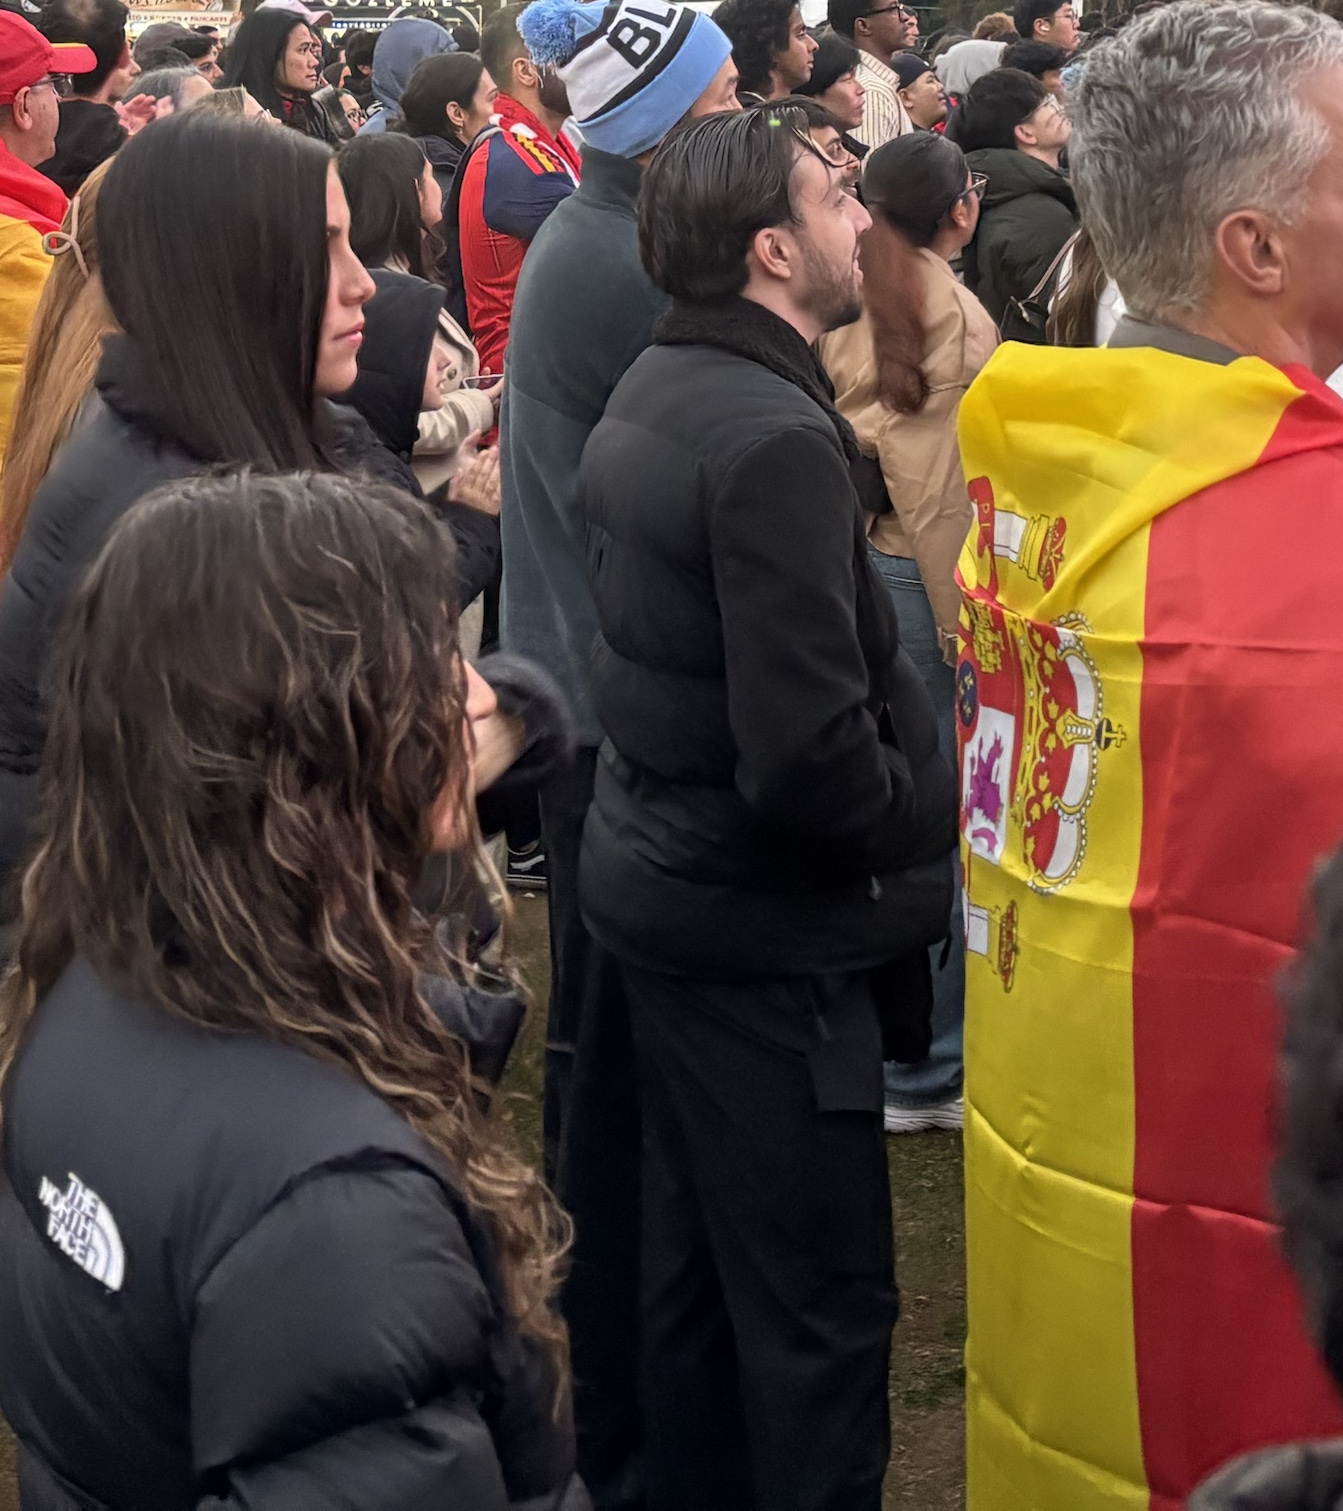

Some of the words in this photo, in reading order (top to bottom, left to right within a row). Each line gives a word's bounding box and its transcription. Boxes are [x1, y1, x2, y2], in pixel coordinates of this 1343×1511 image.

[39, 1176, 94, 1243] NORTH
[65, 1180, 100, 1219] THE
[47, 1217, 91, 1264] FACE
